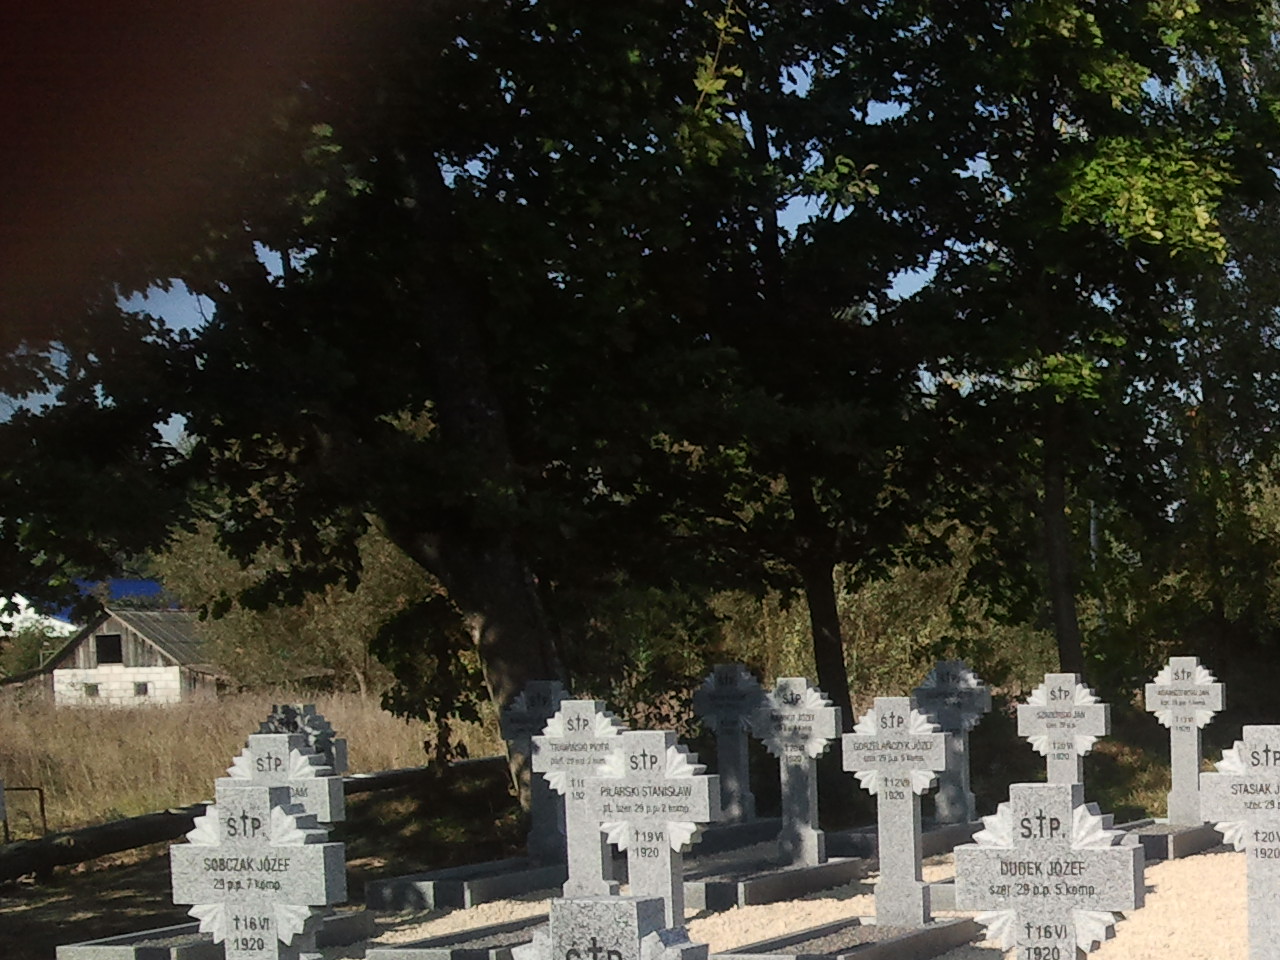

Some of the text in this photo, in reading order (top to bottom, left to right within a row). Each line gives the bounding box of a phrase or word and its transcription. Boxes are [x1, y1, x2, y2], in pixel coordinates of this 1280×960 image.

[1231, 784, 1272, 795] STASIAK
[572, 792, 585, 800] 192
[1265, 800, 1275, 810] 29
[635, 847, 659, 857] 1920
[1254, 848, 1280, 859] 1920
[204, 856, 291, 872] SOBCZAK JÓZEF
[1000, 859, 1086, 876] DUDEK JÓZEF
[213, 879, 224, 890] 29
[1016, 884, 1030, 896] 29
[1054, 925, 1067, 939] VI
[233, 938, 265, 951] 1920
